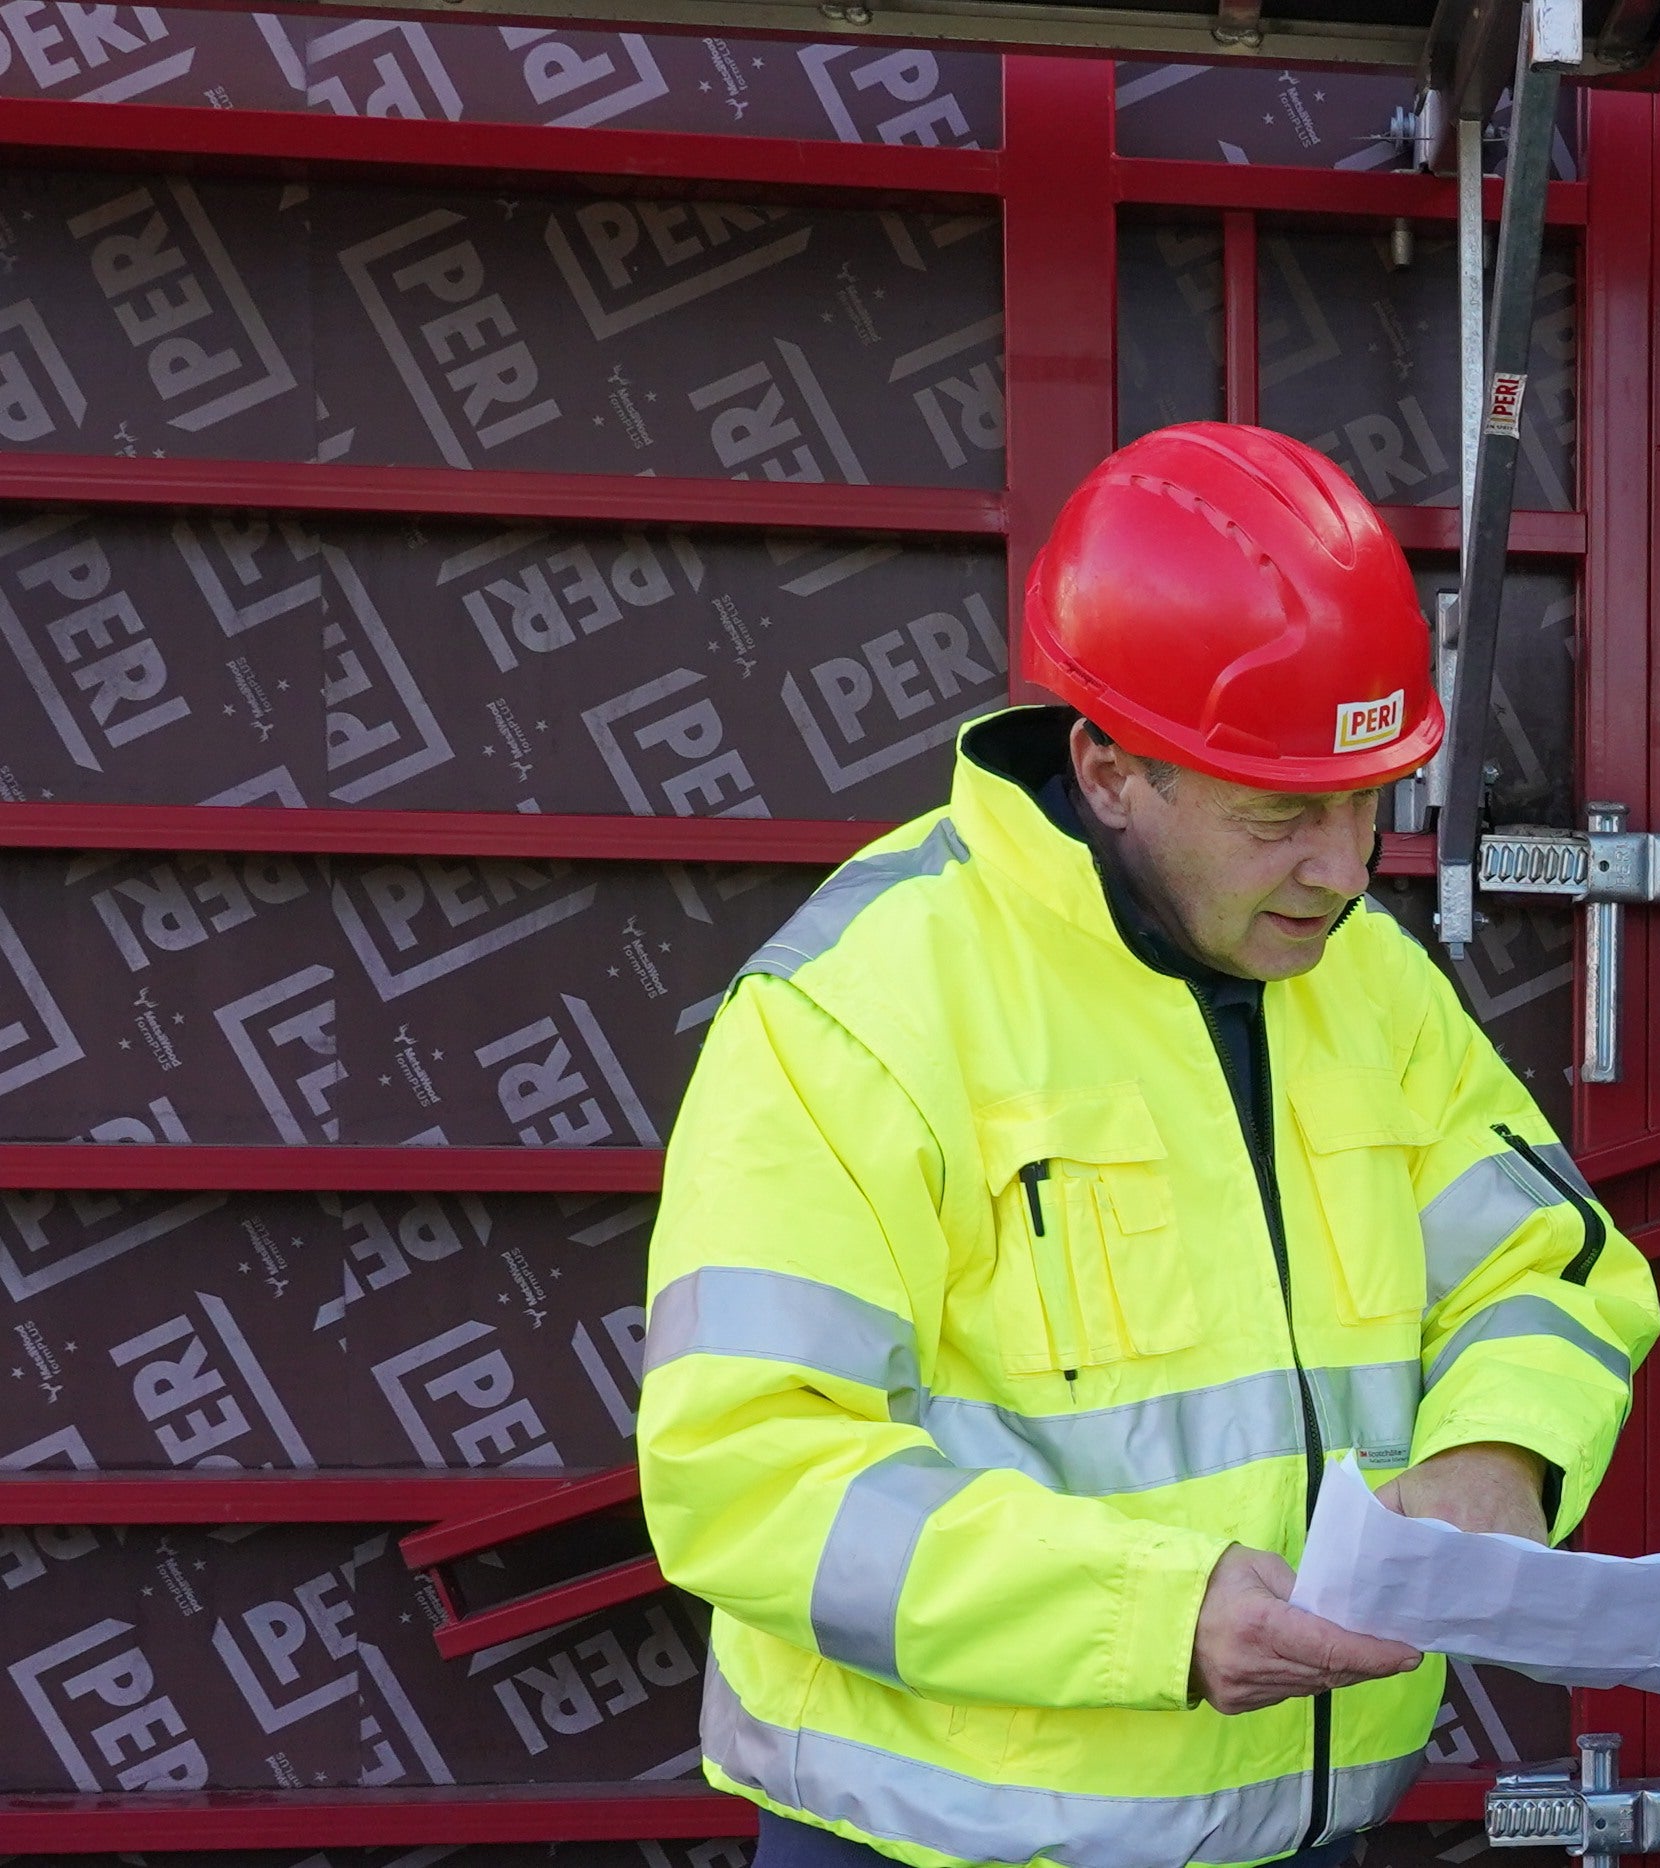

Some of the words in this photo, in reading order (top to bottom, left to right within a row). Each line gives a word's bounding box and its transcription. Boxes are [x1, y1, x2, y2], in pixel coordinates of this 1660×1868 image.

[66, 186, 244, 401] PERI
[391, 239, 563, 450] PERI
[1492, 377, 1520, 416] PERI
[17, 537, 192, 748] PERI
[1351, 701, 1397, 736] PERI
[474, 1015, 613, 1147] ERI
[494, 1605, 700, 1757] PERI
